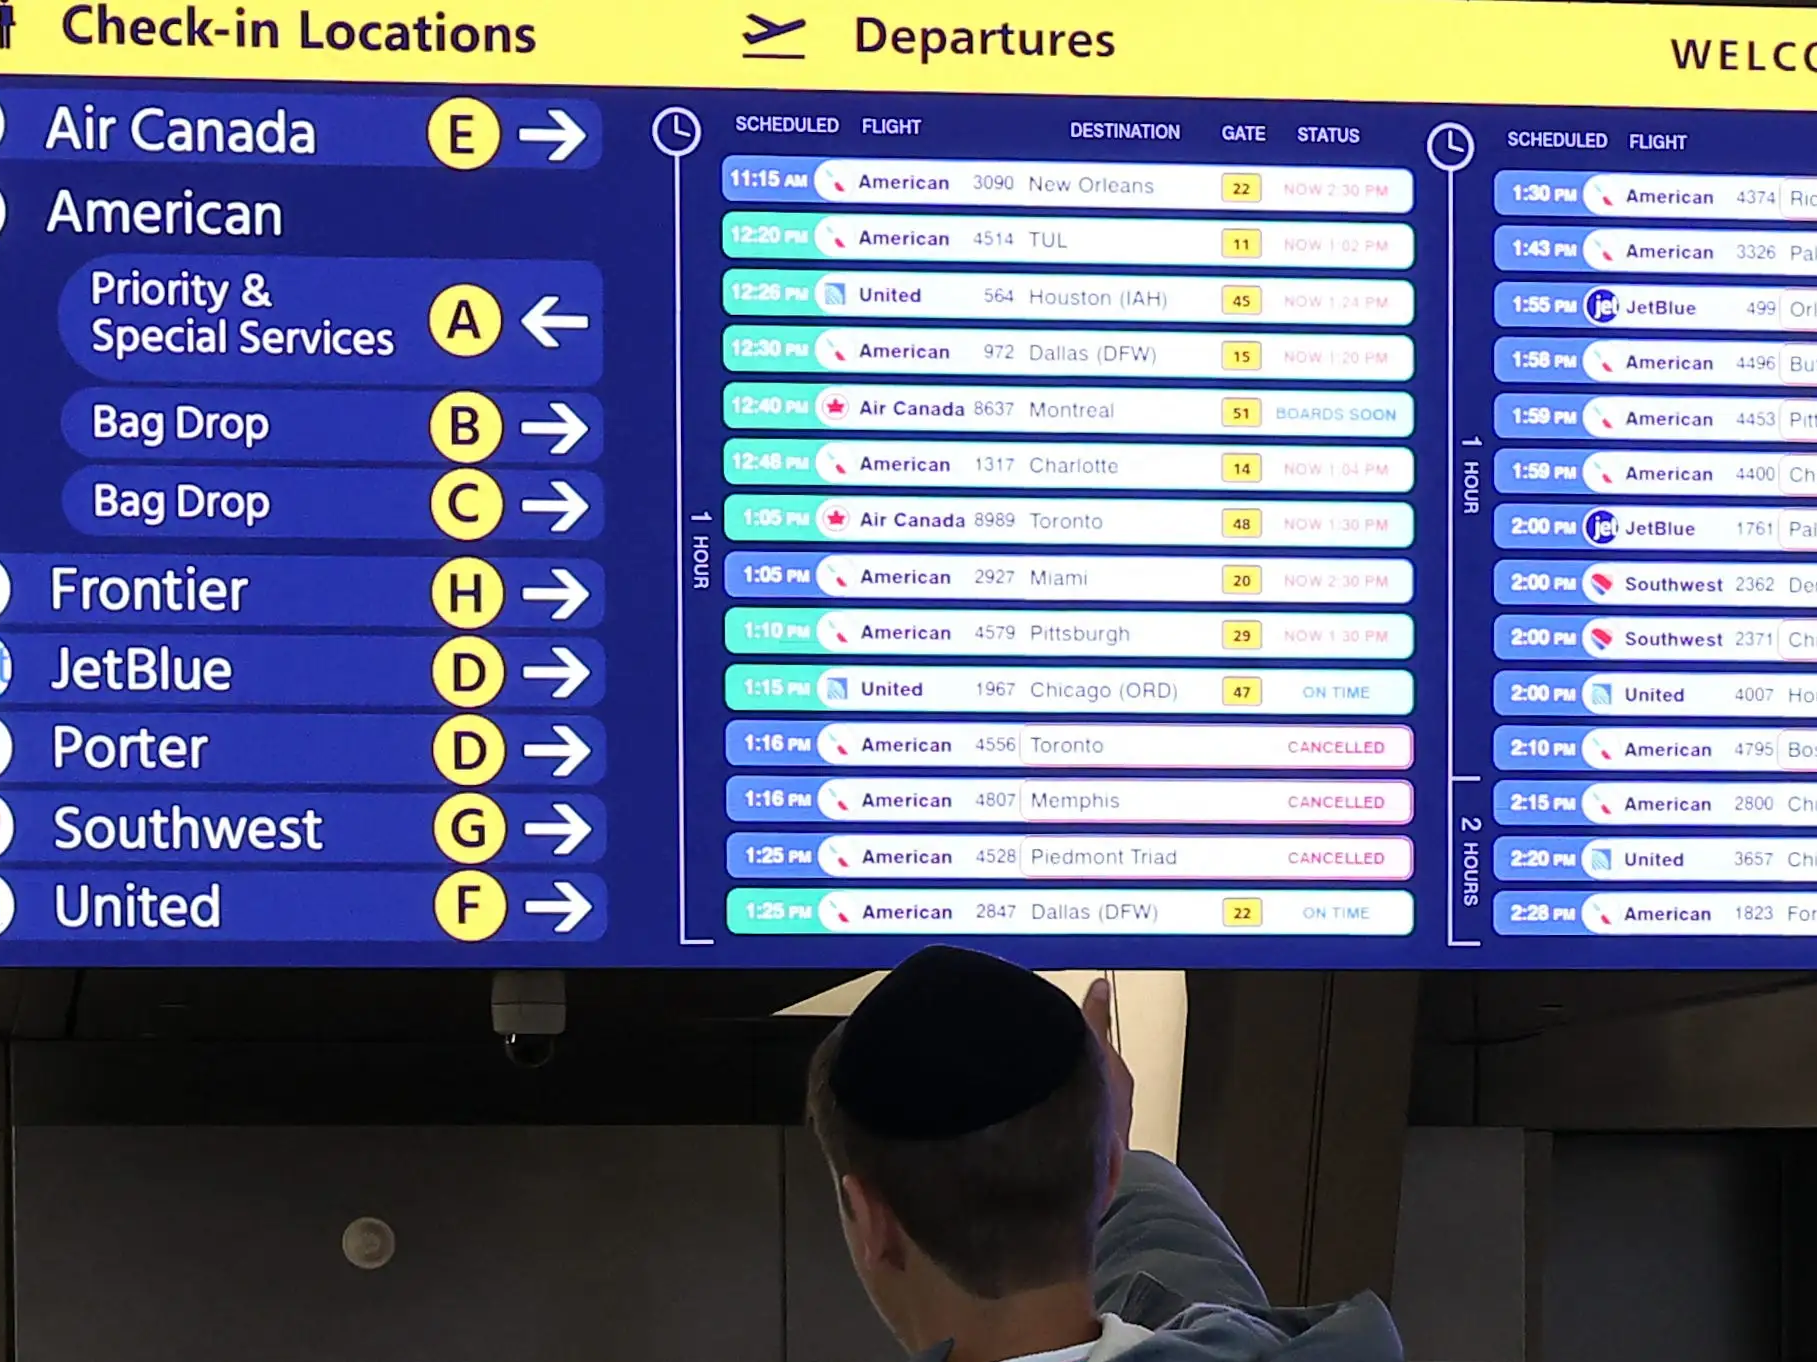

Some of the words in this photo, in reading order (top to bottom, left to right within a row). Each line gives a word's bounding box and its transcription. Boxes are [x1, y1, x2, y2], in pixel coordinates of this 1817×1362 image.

[63, 3, 278, 48] Check-in
[301, 10, 536, 53] Locations
[857, 17, 1115, 64] Departures
[45, 105, 116, 150] Air
[131, 107, 316, 153] Canada
[450, 115, 474, 154] E
[736, 116, 839, 132] SCHEDULED
[863, 118, 921, 134] FLIGHT
[1071, 122, 1180, 139] DESTINATION
[1222, 125, 1266, 141] GATE
[1298, 127, 1359, 143] STATUS
[1508, 131, 1608, 148] SCHEDULED
[1630, 134, 1687, 149] FLIGHT
[859, 174, 949, 190] American
[1626, 189, 1713, 204] American
[47, 190, 281, 235] American
[91, 269, 230, 313] Priority
[242, 276, 271, 308] &
[93, 318, 227, 359] Special
[240, 320, 395, 355] Services
[447, 300, 481, 339] A
[93, 405, 165, 446] Bag
[177, 406, 270, 447] Drop
[451, 406, 479, 445] B
[893, 401, 964, 416] Canada
[95, 484, 165, 526] Bag
[177, 484, 271, 526] Drop
[448, 483, 478, 522] C
[1464, 462, 1479, 513] HOUR
[694, 537, 709, 588] HOUR
[51, 566, 248, 611] Frontier
[450, 573, 481, 612] H
[1626, 577, 1723, 592] Southwest
[50, 648, 233, 692] JetBlue
[454, 653, 486, 691] D
[55, 726, 210, 768] Porter
[454, 731, 486, 770] D
[862, 737, 951, 752] American
[55, 805, 322, 850] Southwest
[452, 808, 485, 848] G
[1462, 818, 1481, 831] 2
[1464, 843, 1478, 906] HOURS
[56, 883, 221, 927] United
[458, 885, 480, 924] F
